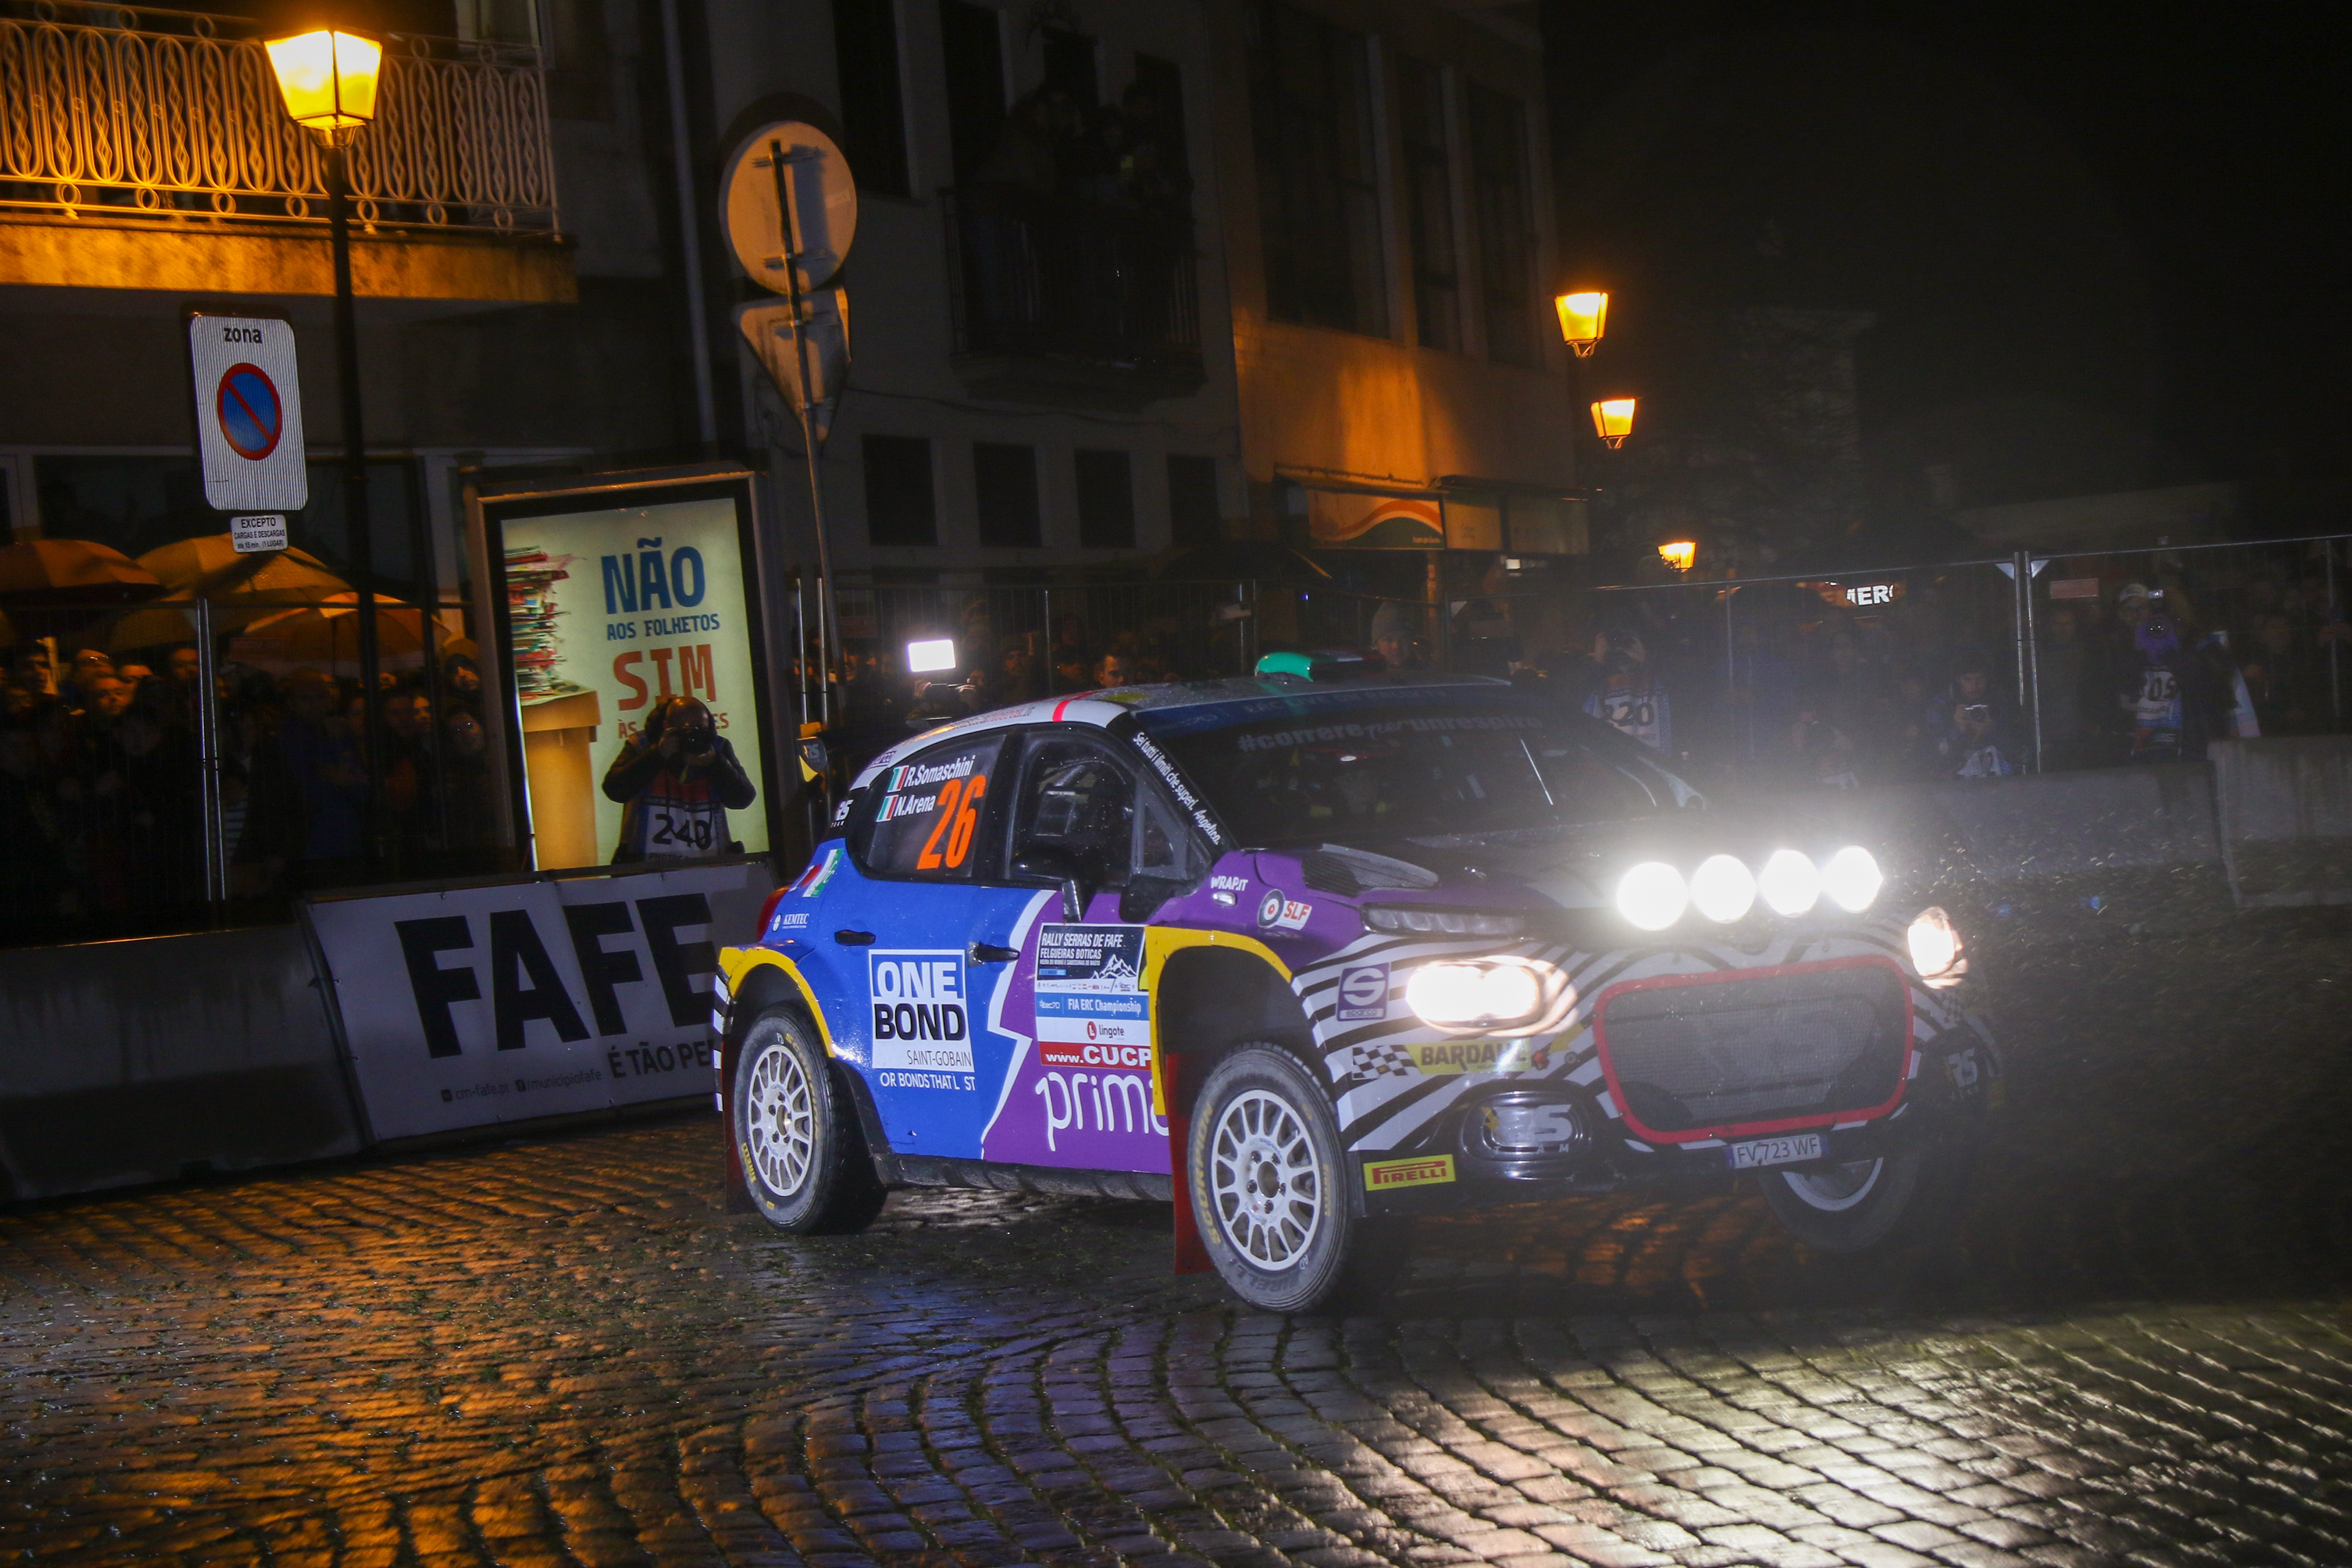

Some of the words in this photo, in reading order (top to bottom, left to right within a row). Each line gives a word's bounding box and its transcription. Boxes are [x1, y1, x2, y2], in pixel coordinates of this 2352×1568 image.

[224, 327, 262, 344] zona
[241, 517, 276, 528] EXCEPTO
[258, 529, 285, 538] DESCARGAS
[601, 536, 706, 614] NÃO
[607, 621, 636, 641] AOS
[644, 613, 720, 637] FOLHETOS
[613, 644, 716, 711] SIM
[617, 719, 637, 739] ÀS
[903, 755, 976, 787] R.Somaschini
[1166, 773, 1180, 788] che
[893, 794, 936, 816] N.Arena
[653, 813, 711, 850] 240
[916, 775, 987, 870] 26
[783, 913, 809, 925] KEMTEC
[1284, 900, 1310, 921] SLF
[1041, 933, 1064, 946] RALLY
[1063, 933, 1093, 947] SERRAS
[1093, 934, 1104, 948] DE
[1104, 934, 1124, 948] FAFE
[1040, 948, 1073, 959] FELGUEIRAS
[1076, 949, 1102, 960] BOTICAS
[394, 893, 716, 1059] FAFE
[877, 961, 958, 999] ONE
[1068, 998, 1079, 1011] FIA
[1081, 999, 1094, 1011] ERC
[1095, 1000, 1141, 1014] Championship
[874, 1003, 966, 1041] BOND
[608, 1046, 626, 1079] É
[625, 1041, 674, 1076] TÃO
[678, 1038, 714, 1069] PE
[907, 1050, 972, 1067] SAINT-GOBAIN
[1421, 1043, 1527, 1071] BARDAL
[455, 1084, 510, 1100] cm-fafe.pt
[880, 1072, 897, 1087] OR
[898, 1072, 930, 1088] BONDS
[930, 1074, 952, 1090] THAT
[1737, 1145, 1757, 1163] FV
[1759, 1142, 1790, 1160] 723
[1793, 1137, 1817, 1155] WF
[1372, 1161, 1447, 1185] PIRELLI
